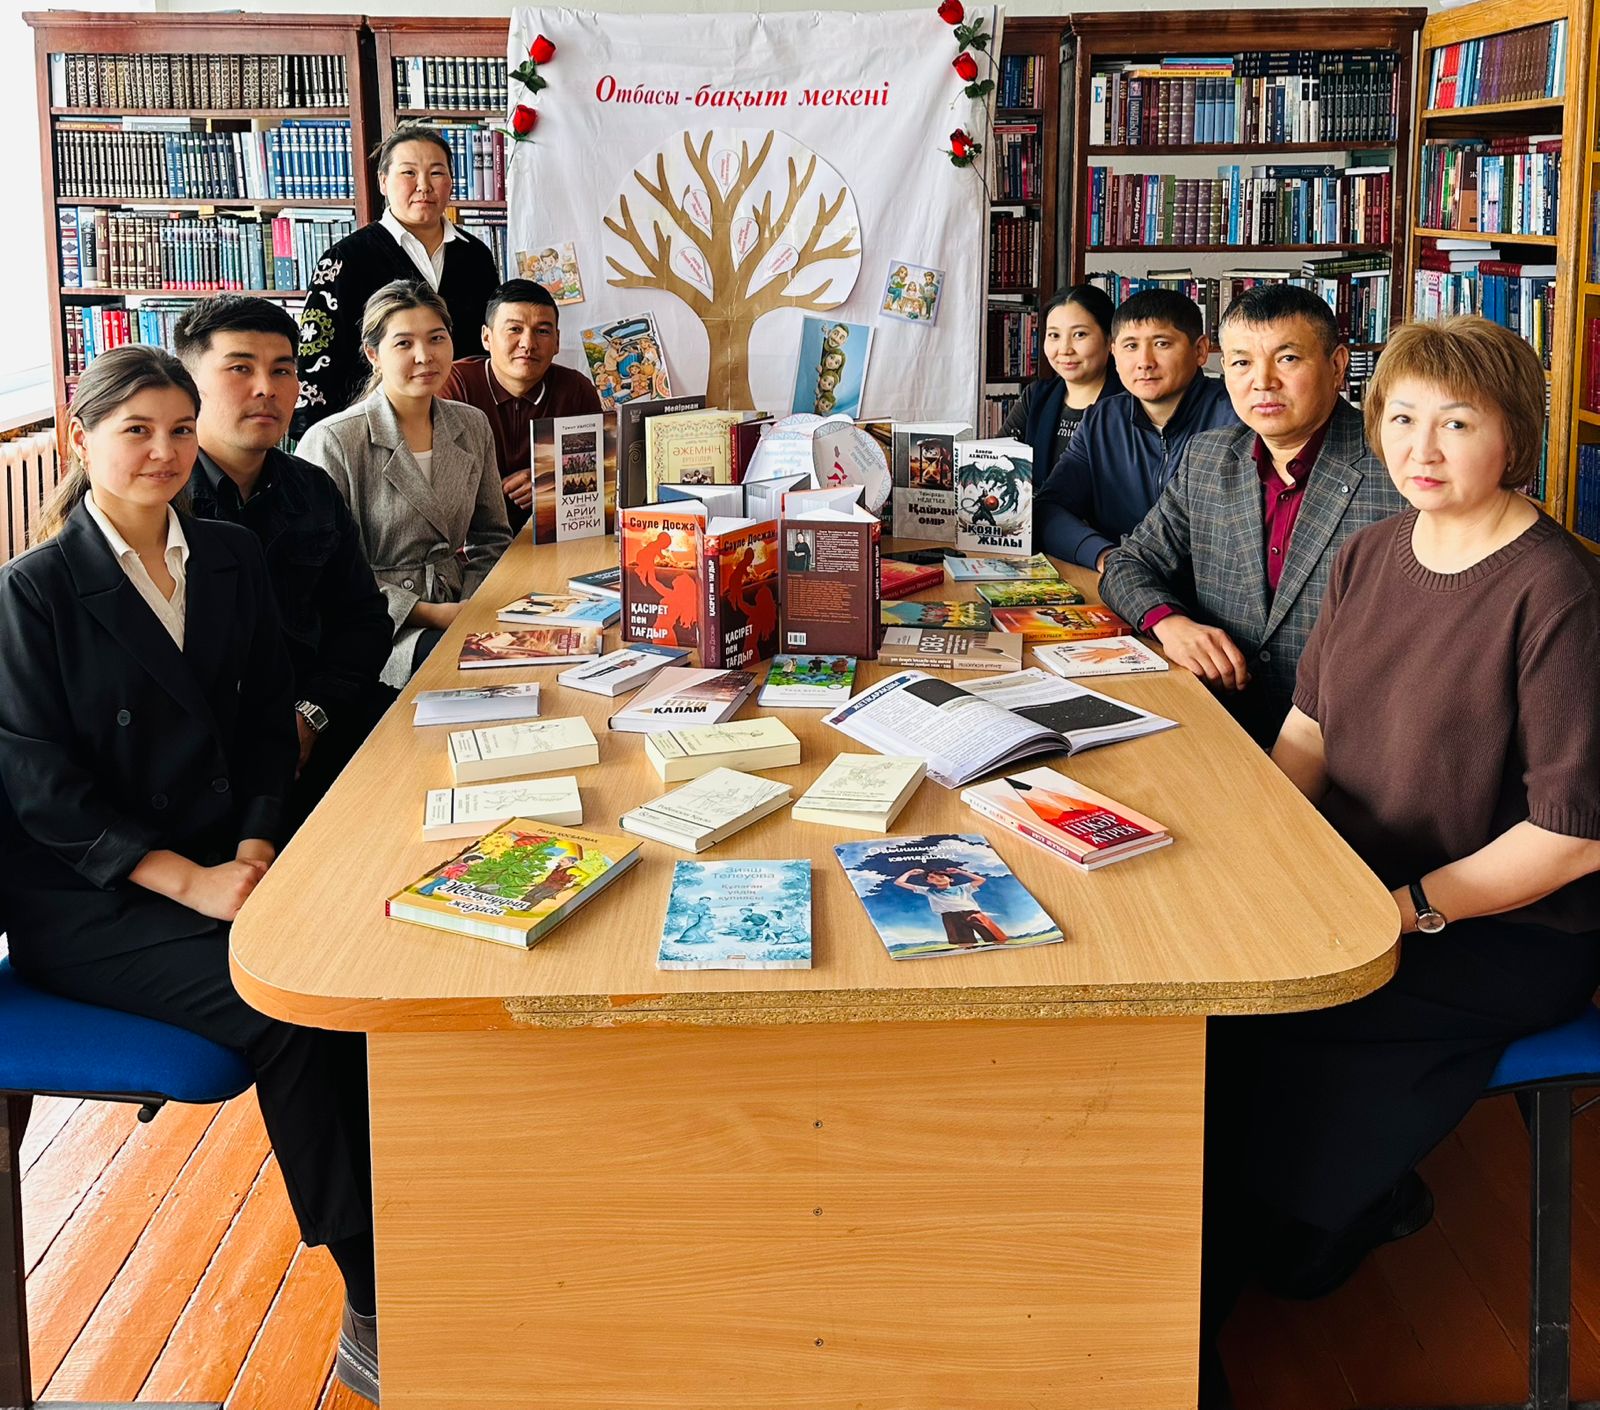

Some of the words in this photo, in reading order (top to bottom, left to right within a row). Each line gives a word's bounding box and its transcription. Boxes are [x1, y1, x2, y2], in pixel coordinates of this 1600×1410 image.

[595, 75, 679, 105] Отбасы
[798, 81, 889, 106] мекені
[1093, 85, 1103, 103] Е
[561, 493, 599, 506] ХУННУ
[565, 506, 597, 518] АРИИ
[561, 519, 600, 532] ТЮРКИ
[630, 517, 659, 530] Сауле
[662, 519, 695, 531] Досжа
[967, 524, 1001, 536] ҚОЯН
[978, 536, 1023, 548] ЖЫЛЫ
[631, 603, 669, 615] ҚАСІРЕТ
[631, 626, 668, 639] ТАҒДЫР
[725, 624, 753, 644] ҚАСІРЕТ
[725, 644, 738, 655] пен
[726, 649, 754, 668] ТАҒДЫР
[438, 881, 528, 909] Жалқаудың
[449, 901, 503, 916] жазасы
